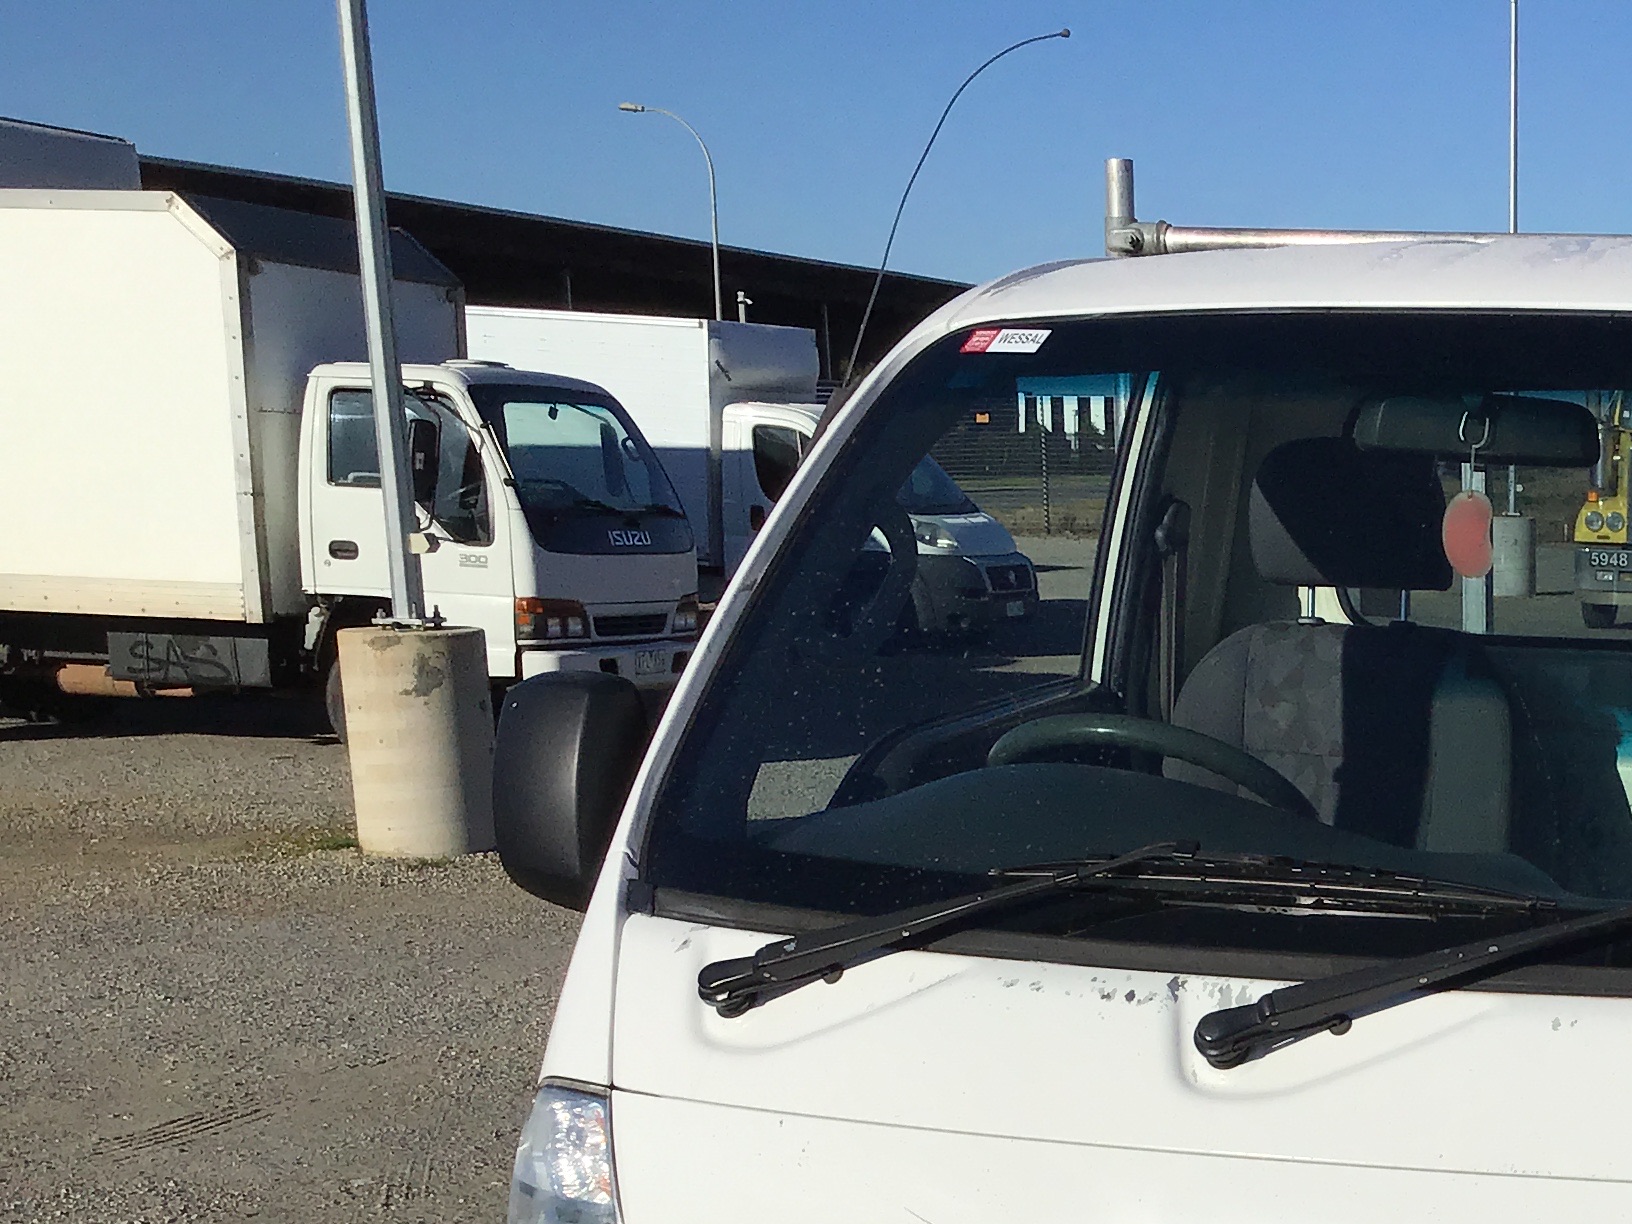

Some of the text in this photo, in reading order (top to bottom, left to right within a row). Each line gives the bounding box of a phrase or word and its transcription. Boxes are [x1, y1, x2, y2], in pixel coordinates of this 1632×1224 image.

[608, 530, 651, 546] ISUZU
[459, 554, 488, 564] 300
[1590, 552, 1628, 567] 5948
